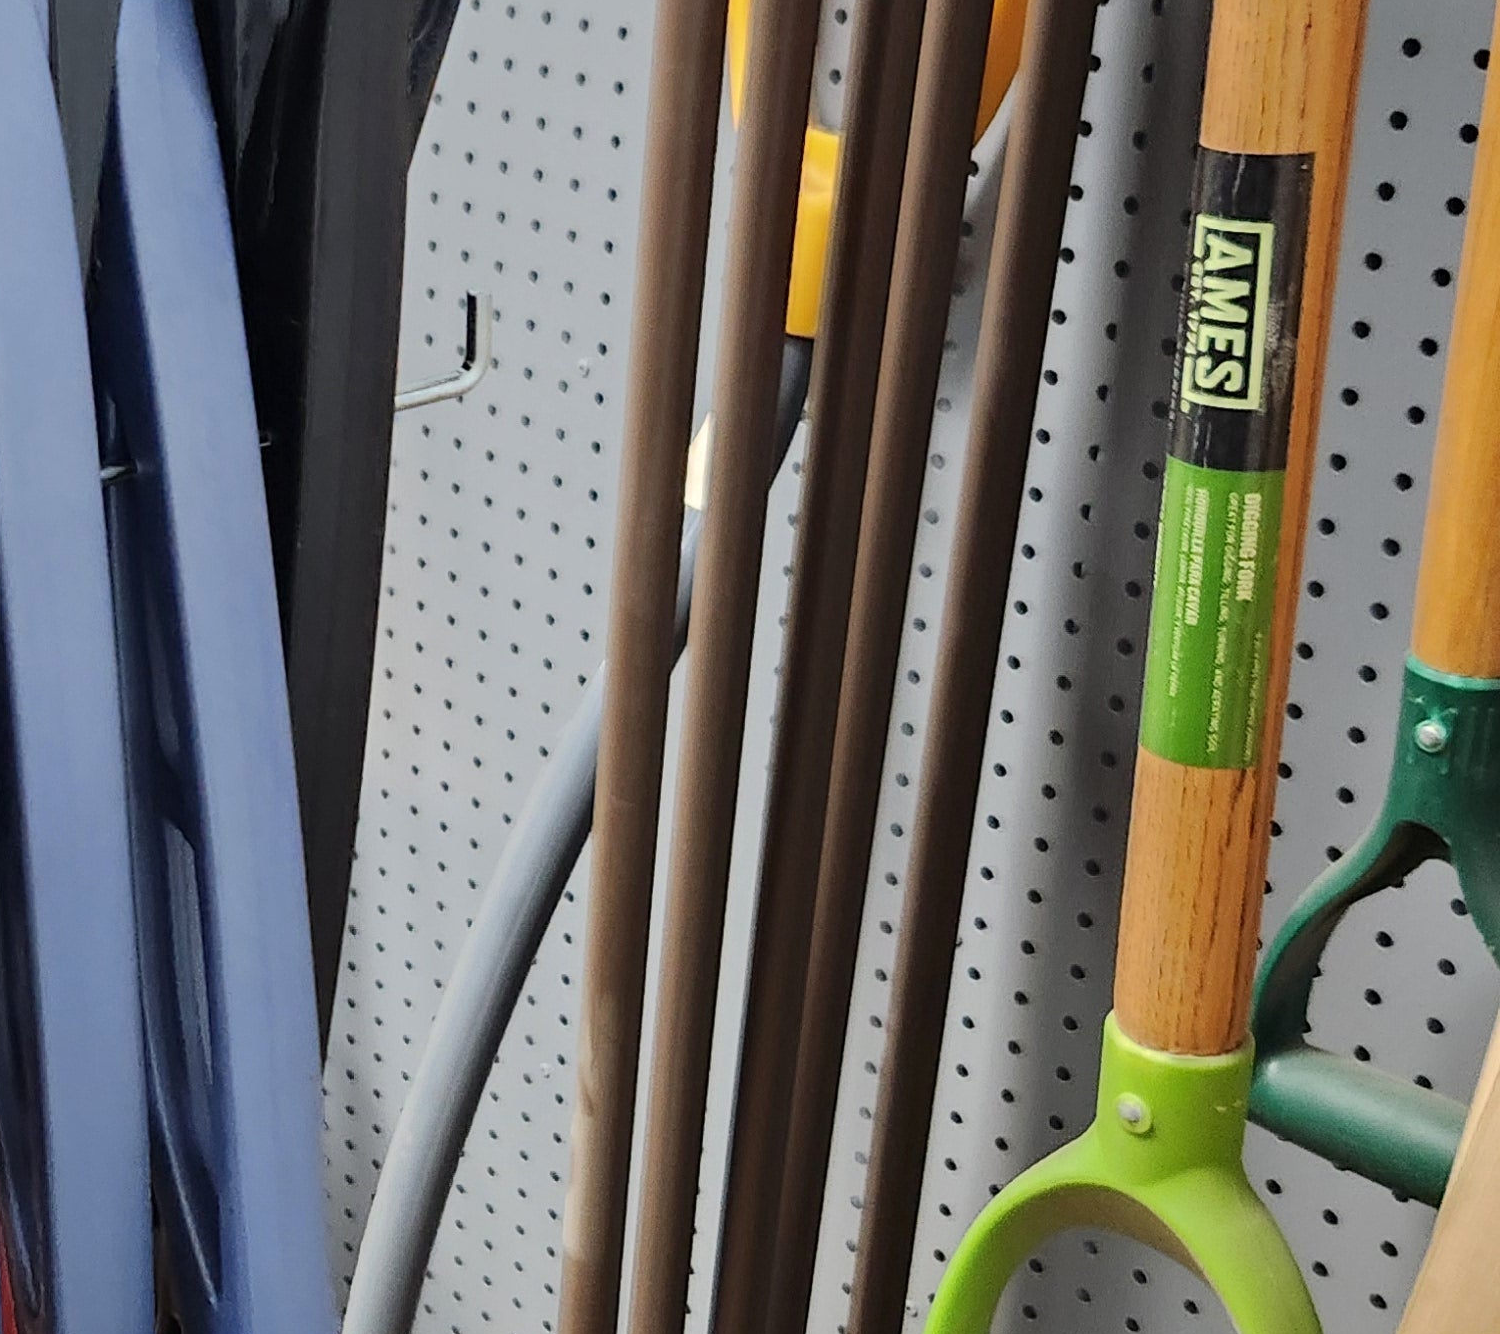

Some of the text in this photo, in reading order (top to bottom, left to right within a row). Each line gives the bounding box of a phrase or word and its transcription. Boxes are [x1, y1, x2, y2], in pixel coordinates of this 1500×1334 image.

[1194, 233, 1254, 393] AMES
[1183, 487, 1210, 627] HORQUILLA PARA CAVAR
[1238, 492, 1262, 559] DIGGING
[1234, 560, 1257, 602] FORK
